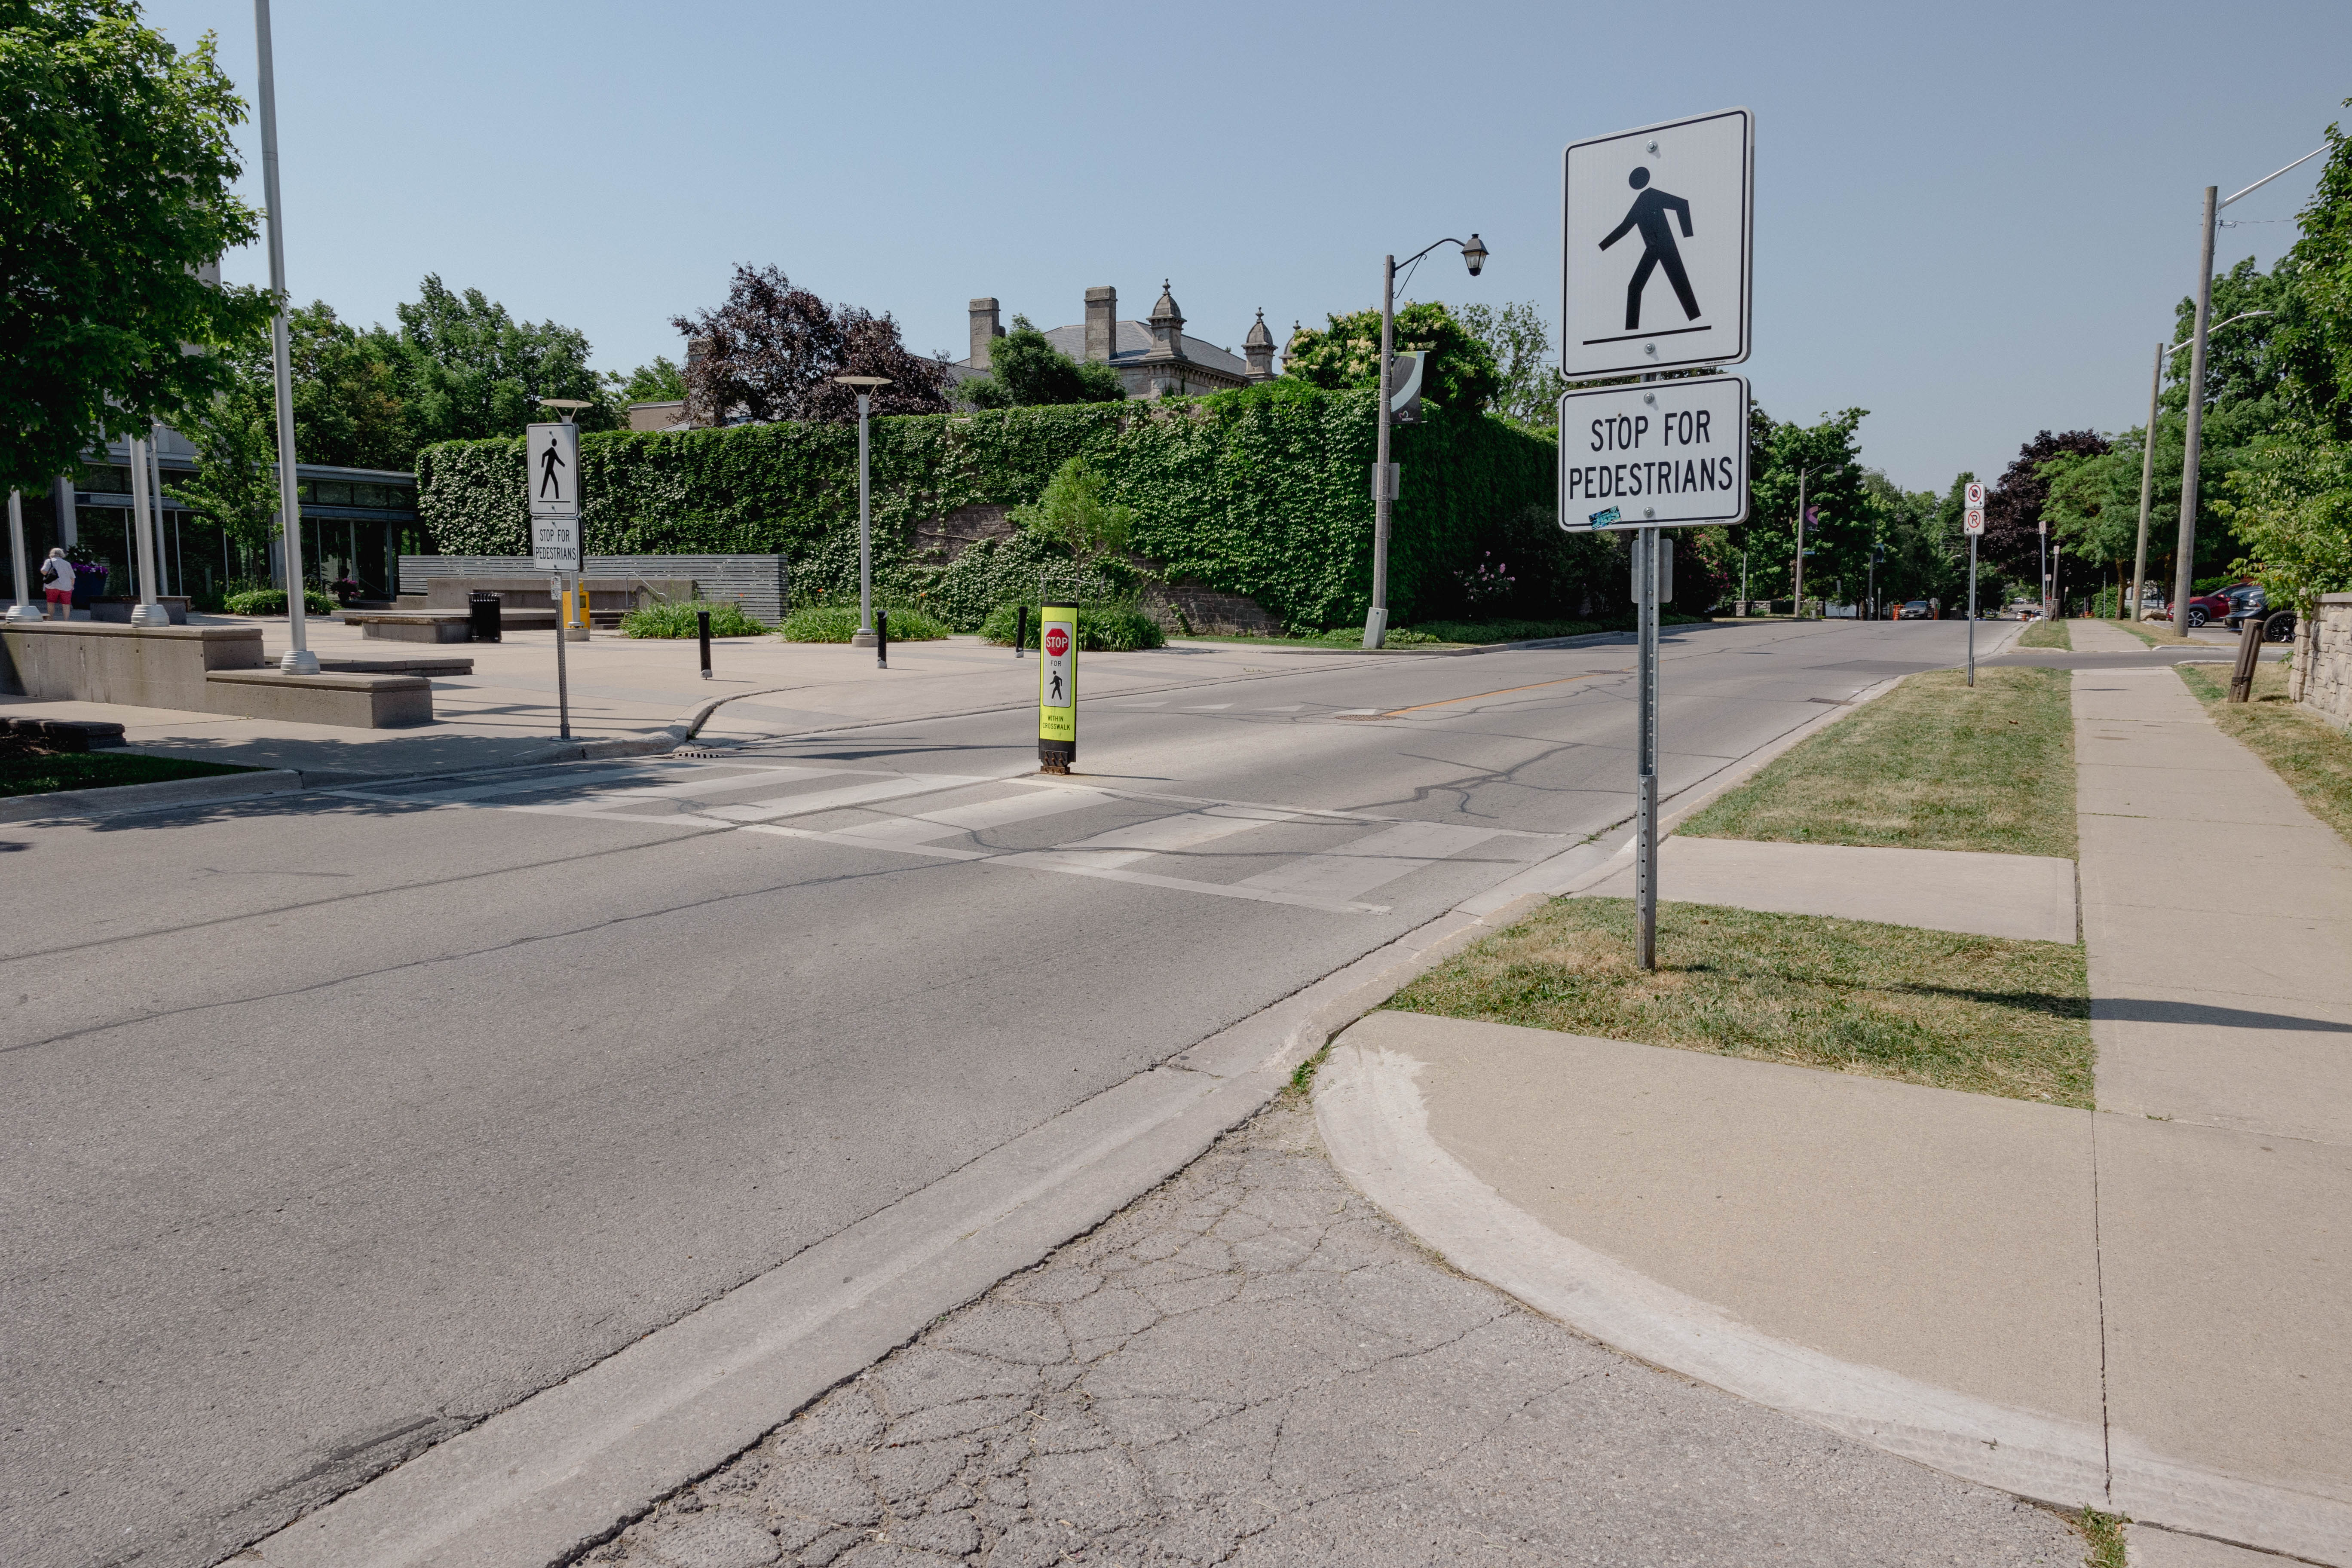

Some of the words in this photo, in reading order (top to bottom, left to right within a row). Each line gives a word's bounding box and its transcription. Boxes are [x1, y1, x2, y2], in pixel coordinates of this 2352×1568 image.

[1591, 416, 1648, 452] STOP
[1664, 410, 1710, 446] FOR
[1570, 456, 1733, 499] PEDESTRIANS
[540, 529, 554, 542] STOP
[557, 529, 570, 542] FOR
[536, 547, 576, 560] PEDESTRIANS
[1046, 637, 1068, 648] STOP
[1042, 723, 1070, 731] CROSSWALK
